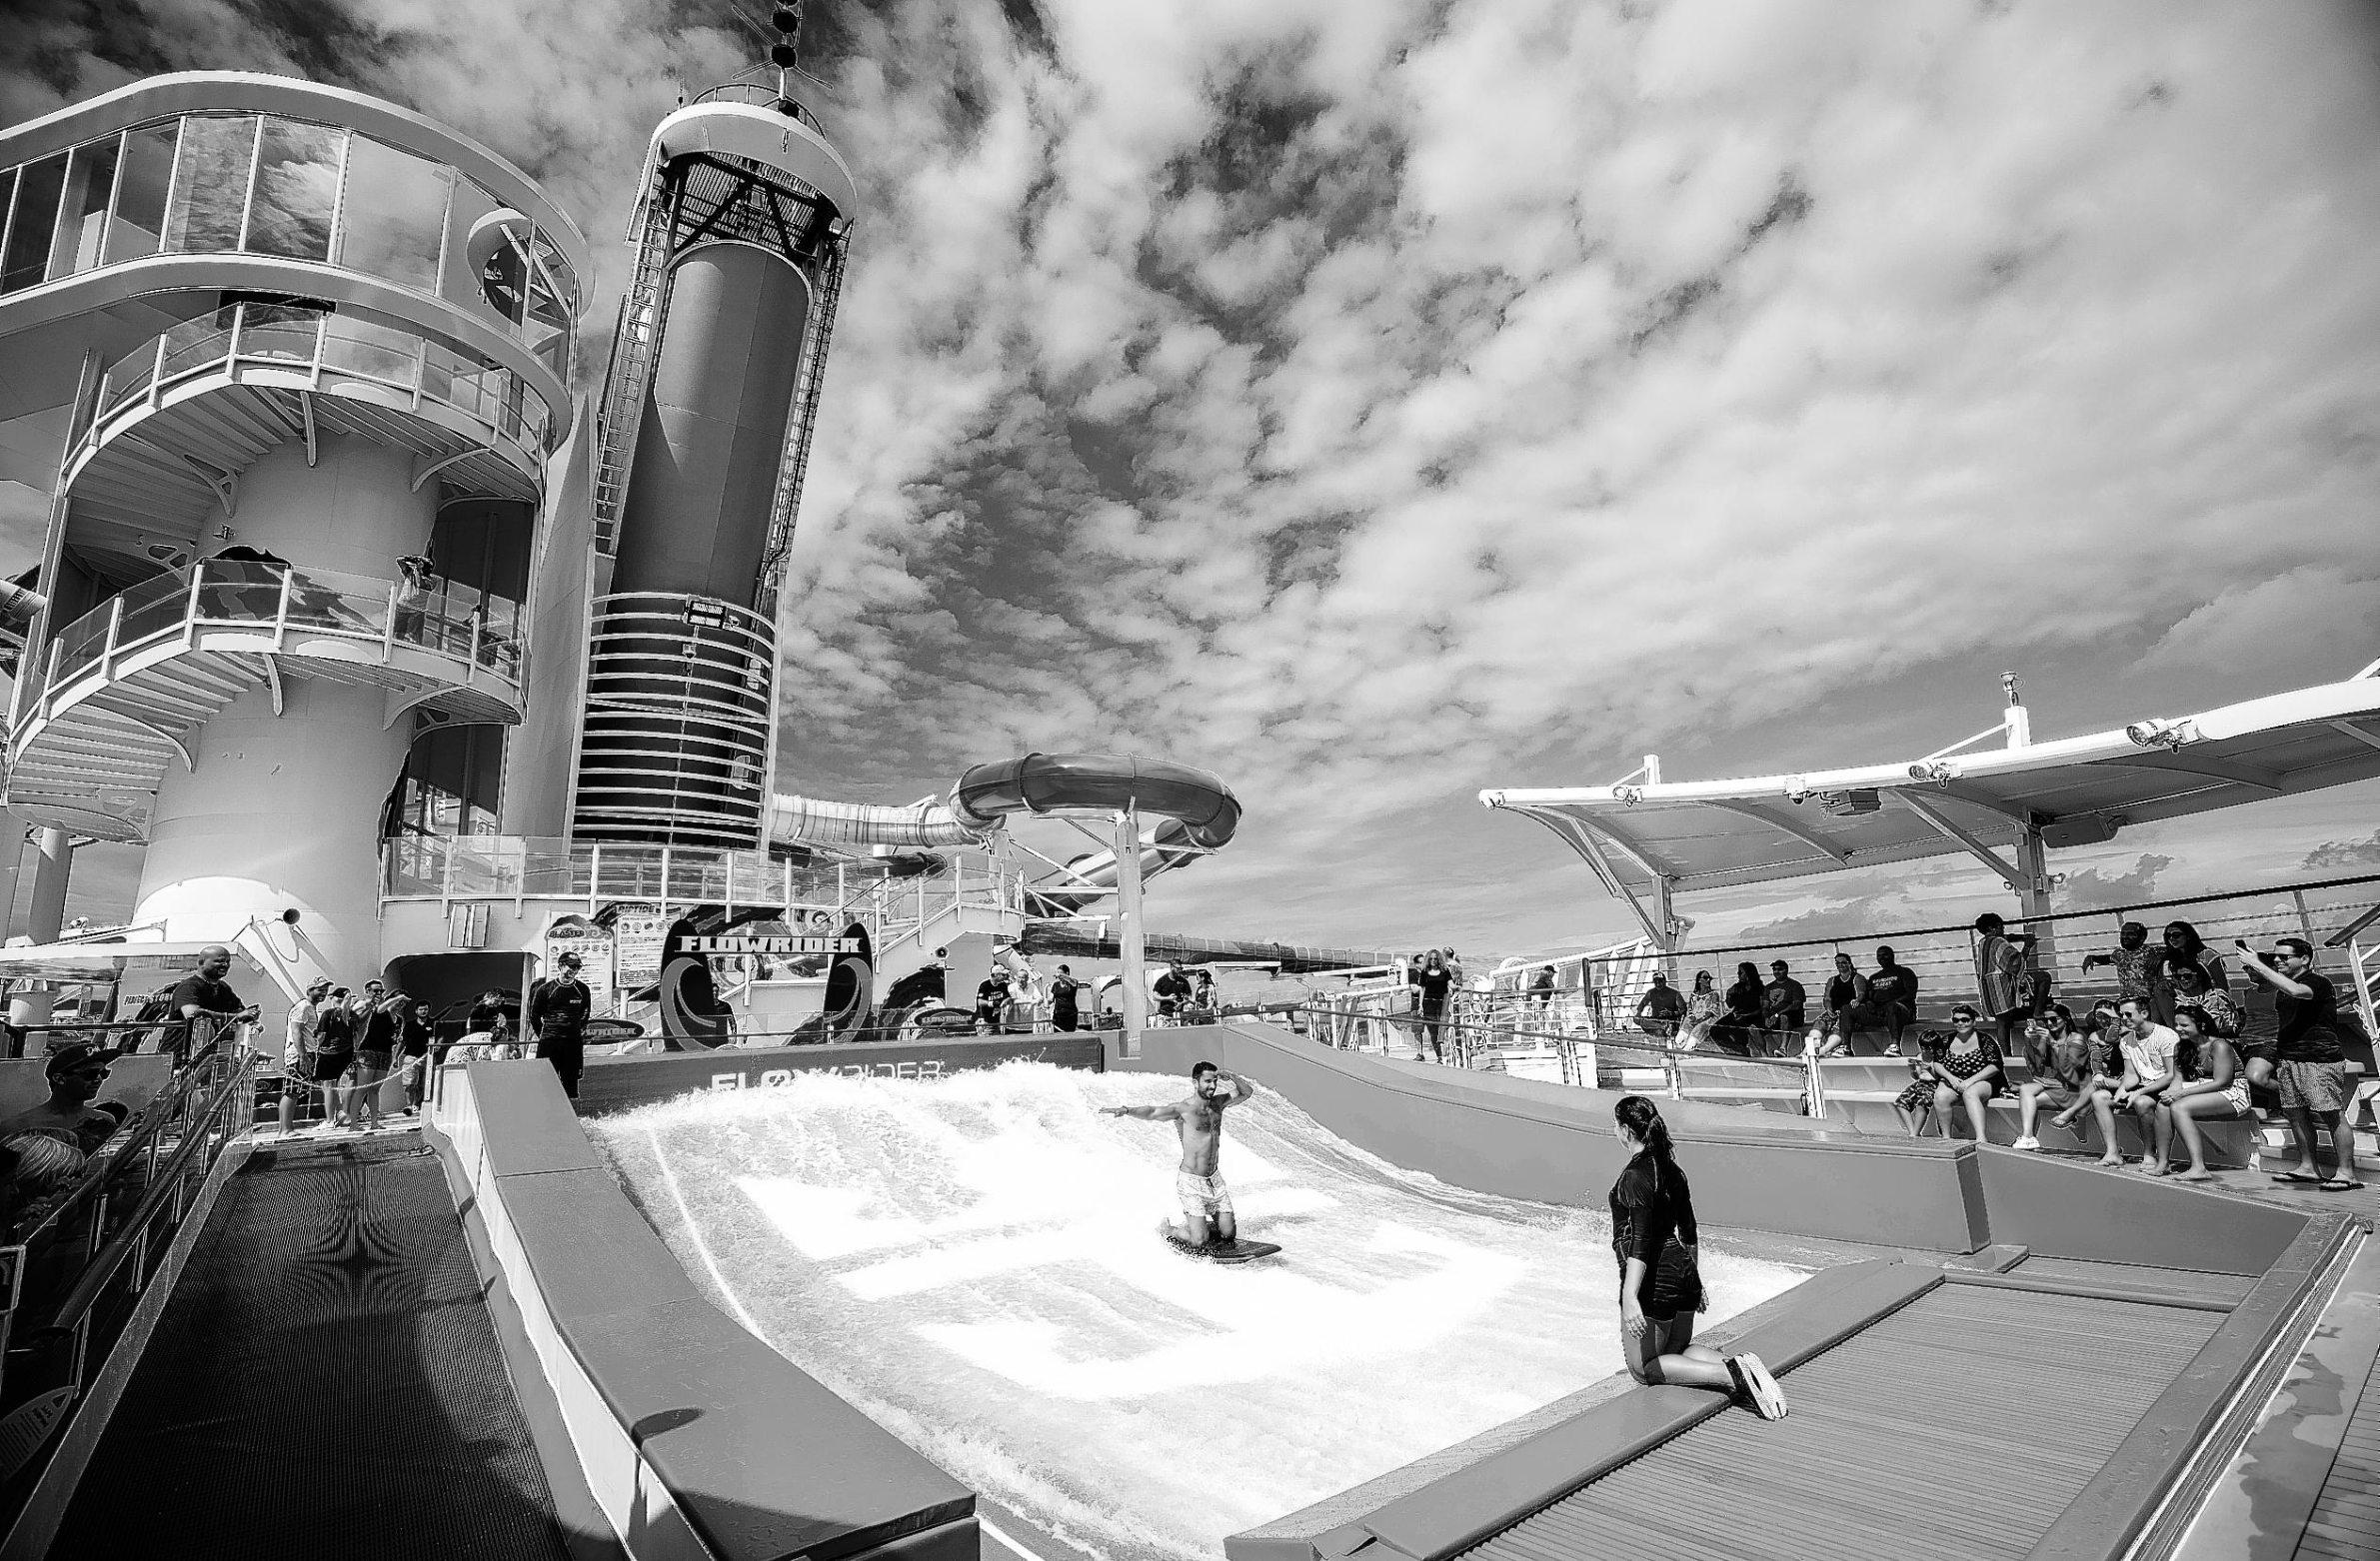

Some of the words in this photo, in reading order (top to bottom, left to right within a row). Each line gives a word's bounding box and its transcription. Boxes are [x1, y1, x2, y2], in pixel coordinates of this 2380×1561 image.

[618, 904, 656, 913] RIPTIDE
[549, 929, 585, 938] BLASTER
[676, 935, 864, 953] FLOWRIDER
